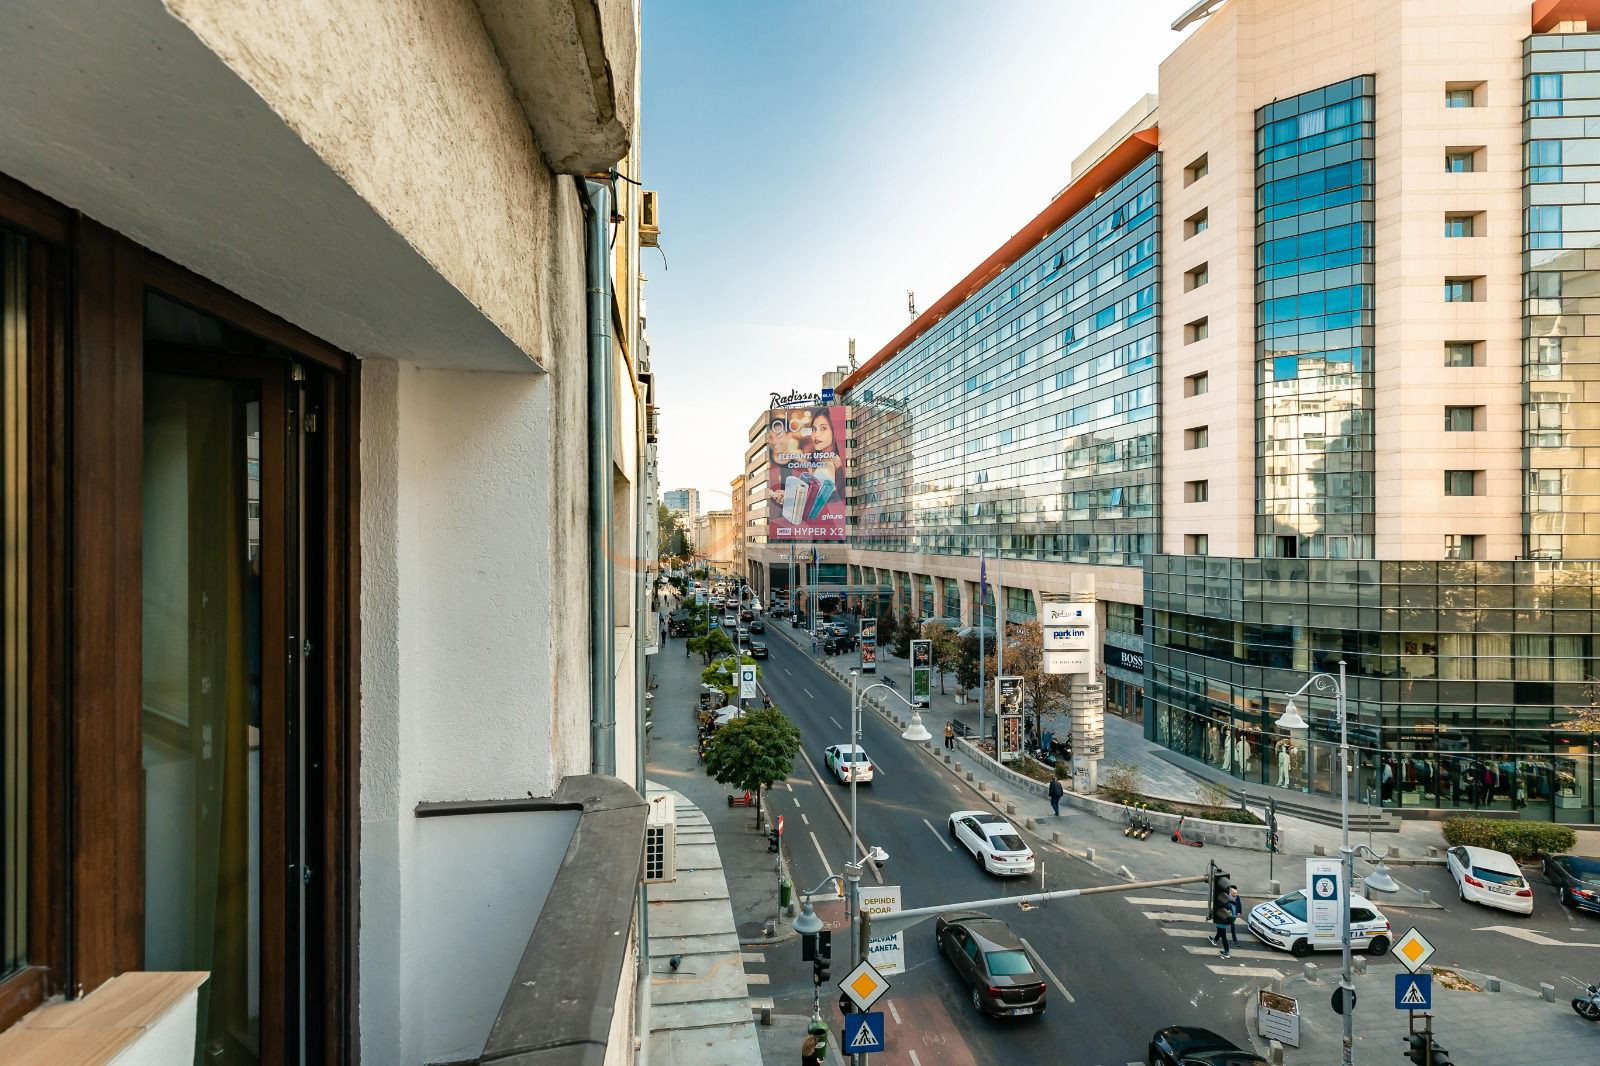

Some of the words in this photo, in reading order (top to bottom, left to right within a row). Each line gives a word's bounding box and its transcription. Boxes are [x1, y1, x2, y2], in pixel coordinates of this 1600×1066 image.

[769, 388, 821, 409] Radisson
[772, 411, 800, 438] glo
[794, 527, 826, 536] HYPER
[829, 527, 844, 536] X2
[1053, 630, 1071, 639] park
[1072, 629, 1085, 637] inn
[1121, 651, 1144, 667] BOSS
[864, 897, 896, 906] DEPINDE
[869, 907, 892, 915] DOAR
